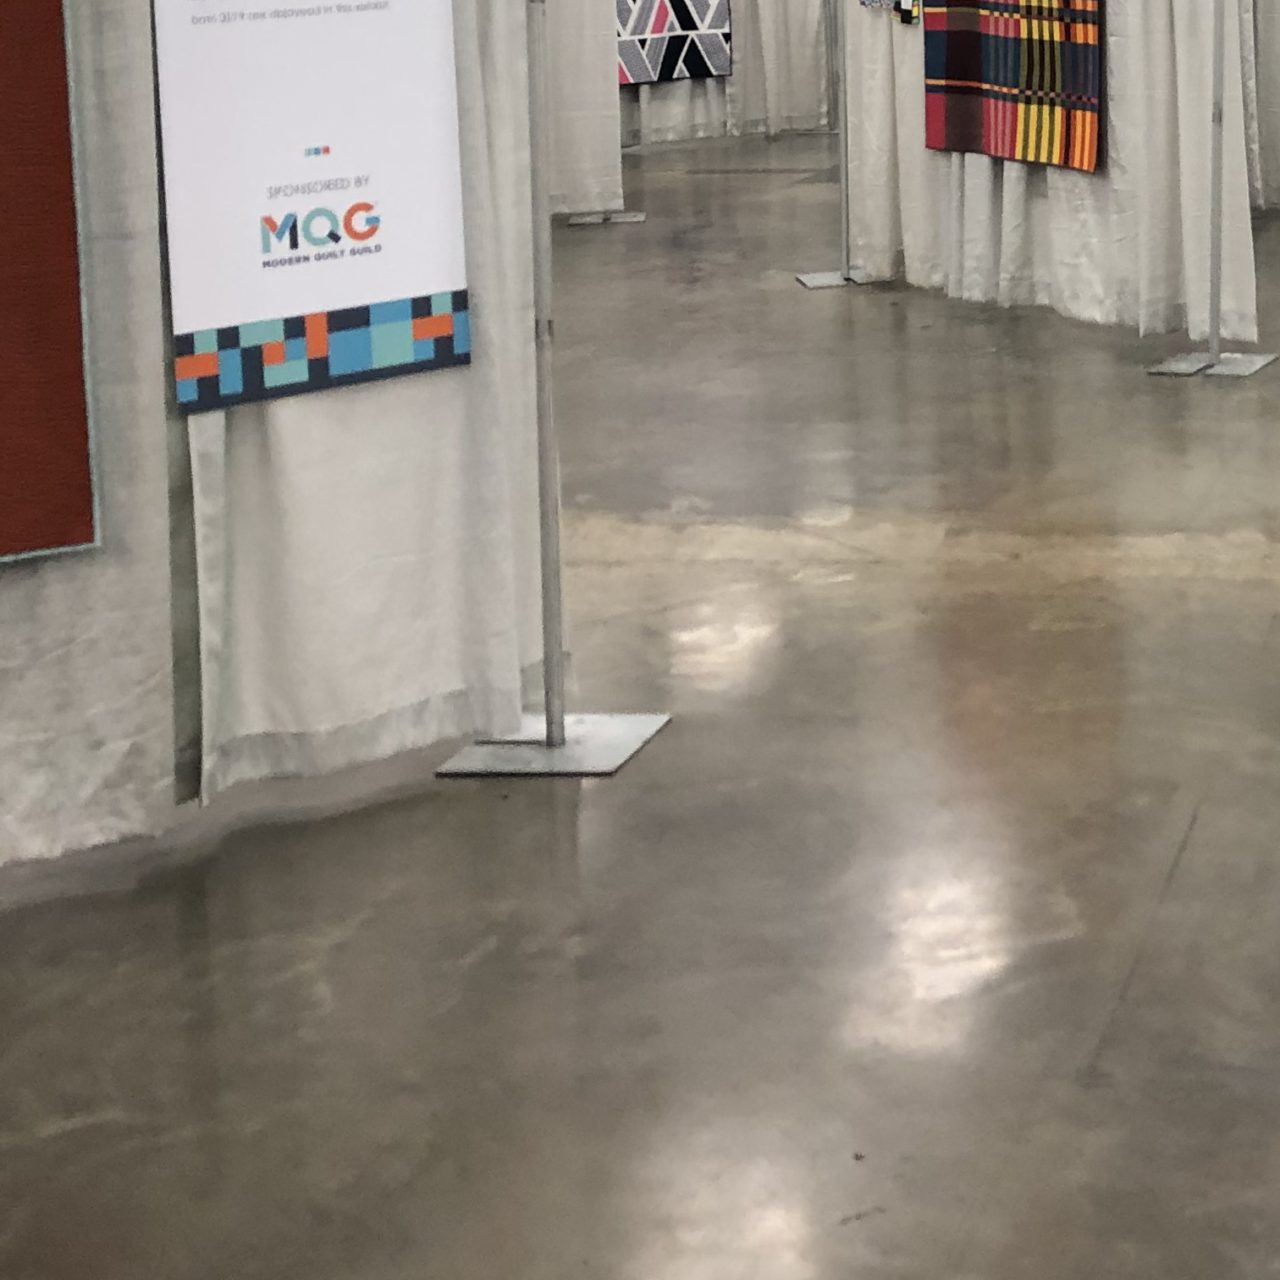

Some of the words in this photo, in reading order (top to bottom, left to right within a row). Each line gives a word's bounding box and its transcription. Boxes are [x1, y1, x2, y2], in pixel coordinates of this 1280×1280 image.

[266, 177, 350, 200] SPONSORED
[354, 175, 370, 188] BY
[259, 202, 381, 254] MQG
[262, 255, 310, 268] MODERN
[314, 249, 346, 262] QUILT
[350, 244, 382, 256] GUILD
